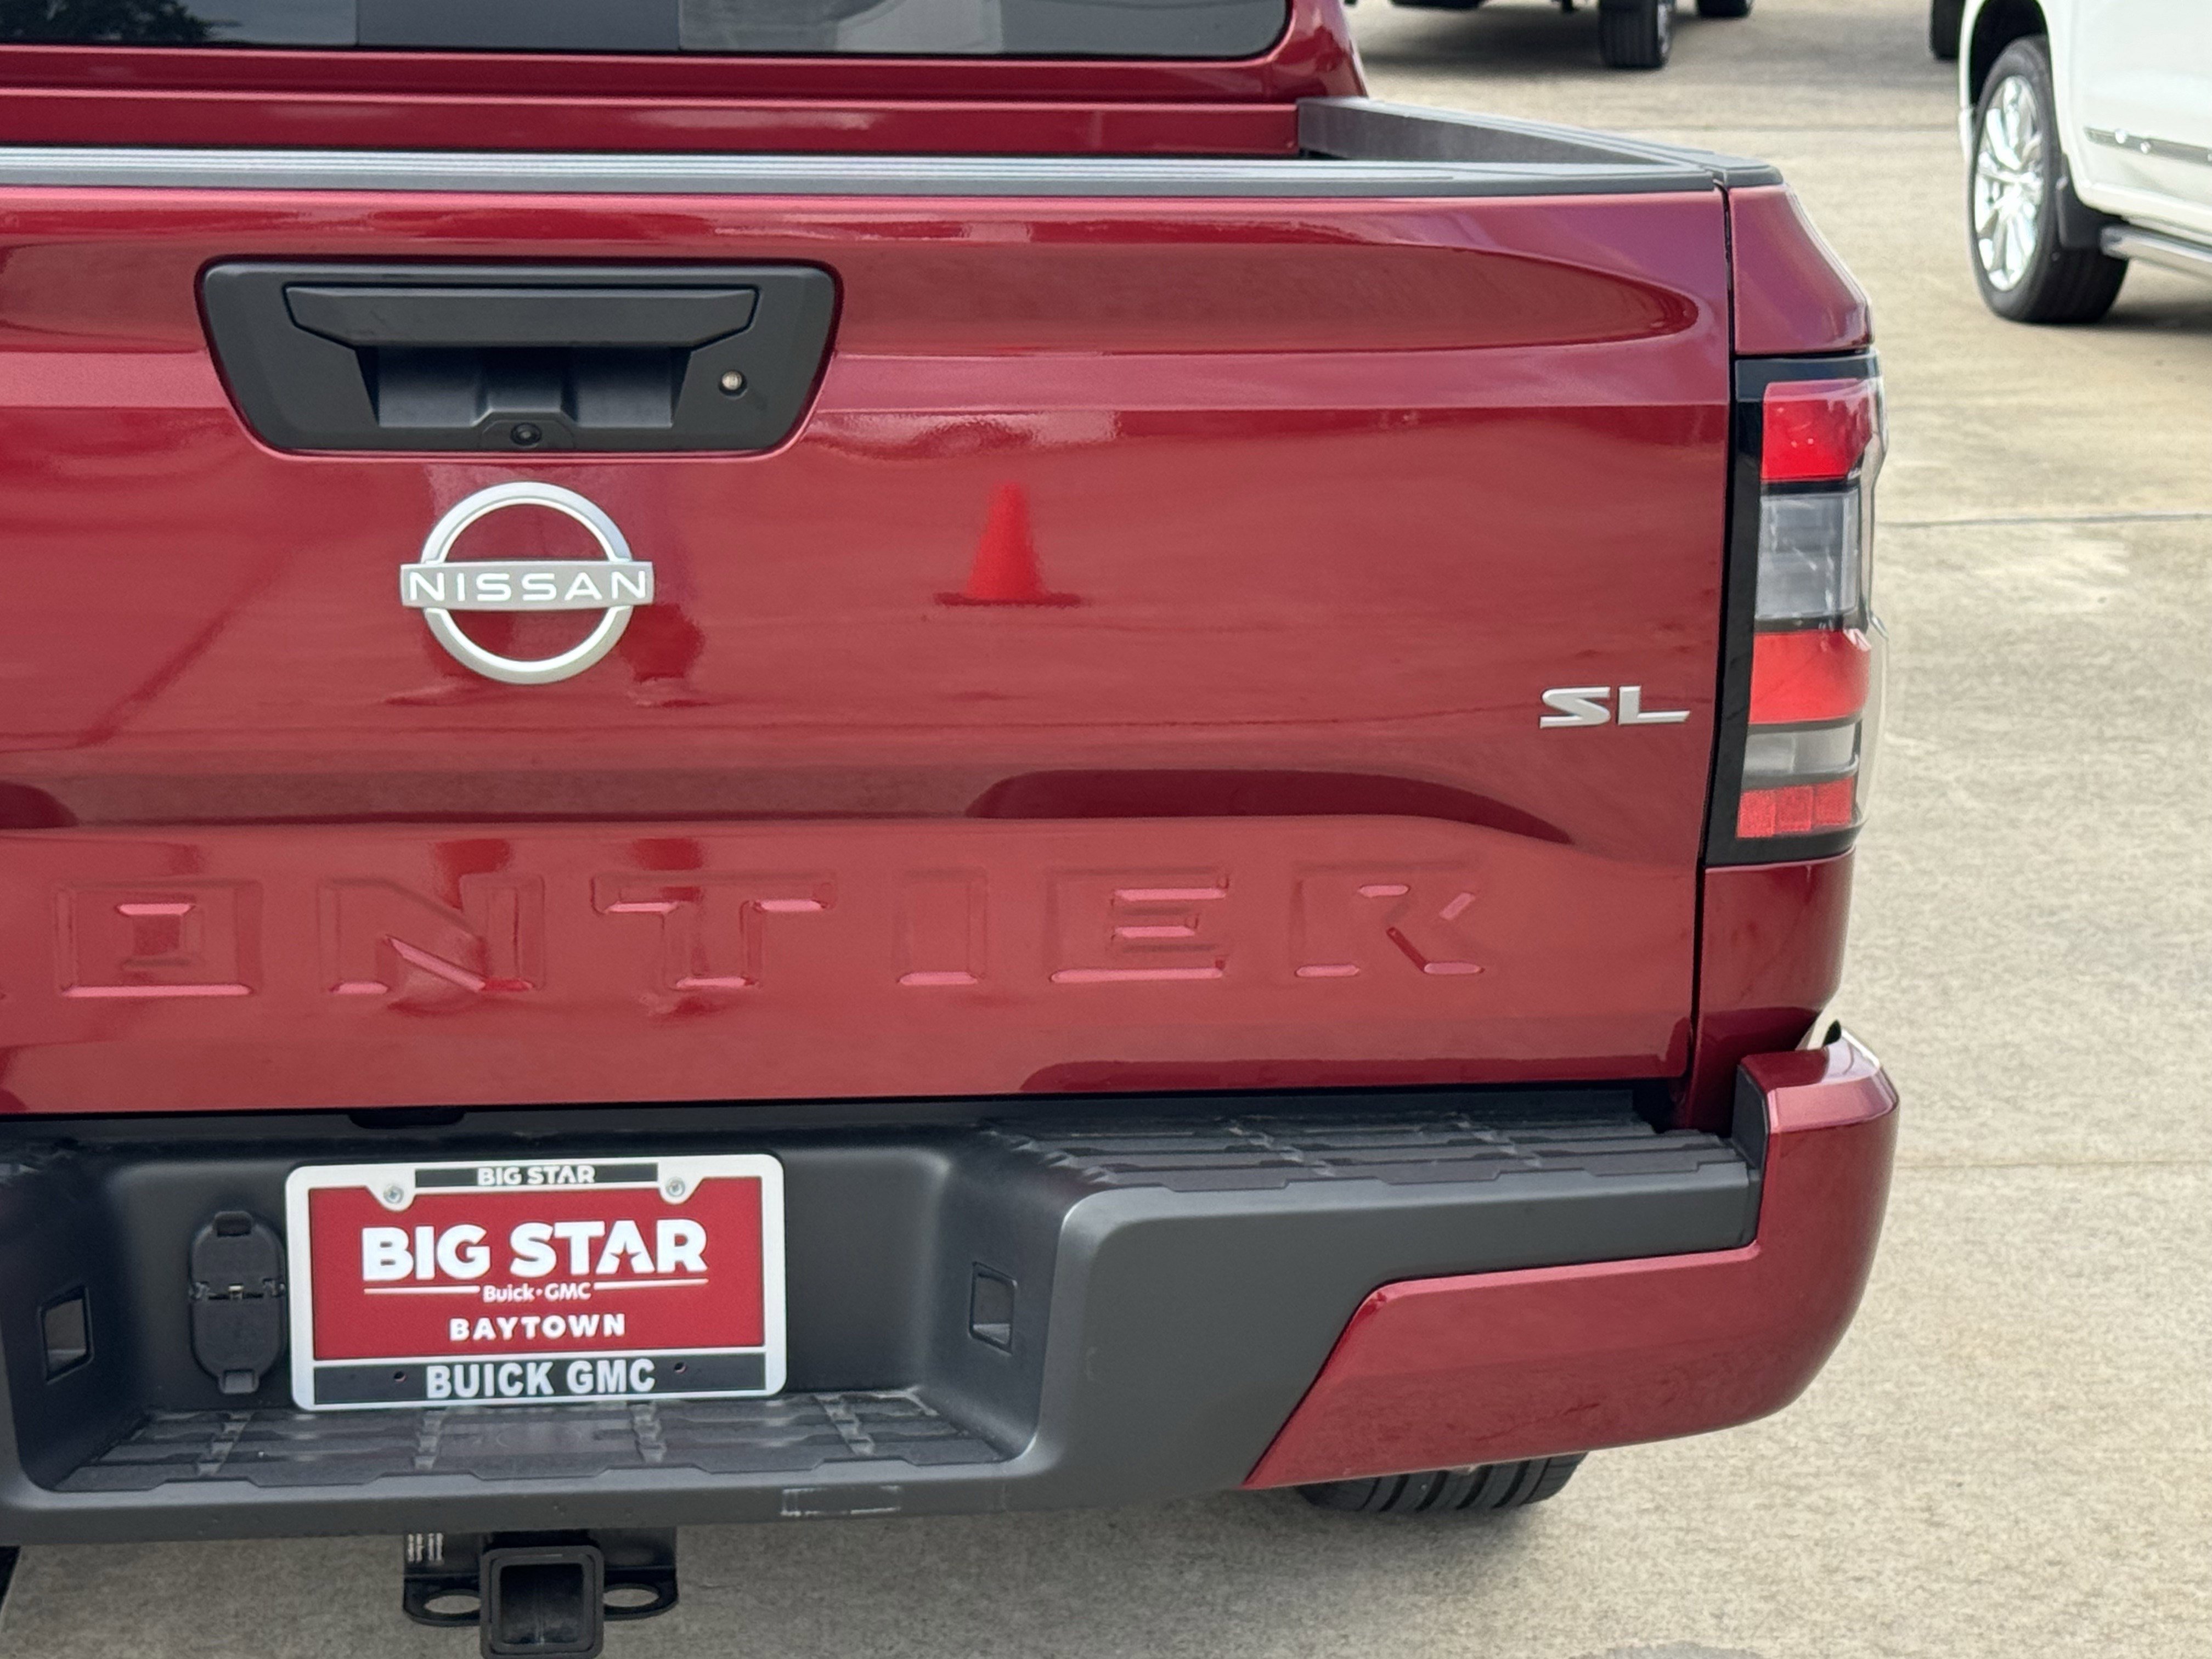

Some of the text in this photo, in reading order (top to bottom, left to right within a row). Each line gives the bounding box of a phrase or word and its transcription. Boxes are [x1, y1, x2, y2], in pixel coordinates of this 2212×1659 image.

[409, 571, 646, 601] NISSAN
[1540, 686, 1690, 728] SL
[477, 1165, 595, 1186] BIG STAR
[362, 1219, 707, 1281] BIG STAR
[450, 1313, 625, 1341] BAYTOWN
[426, 1358, 656, 1398] BUICK GMC
